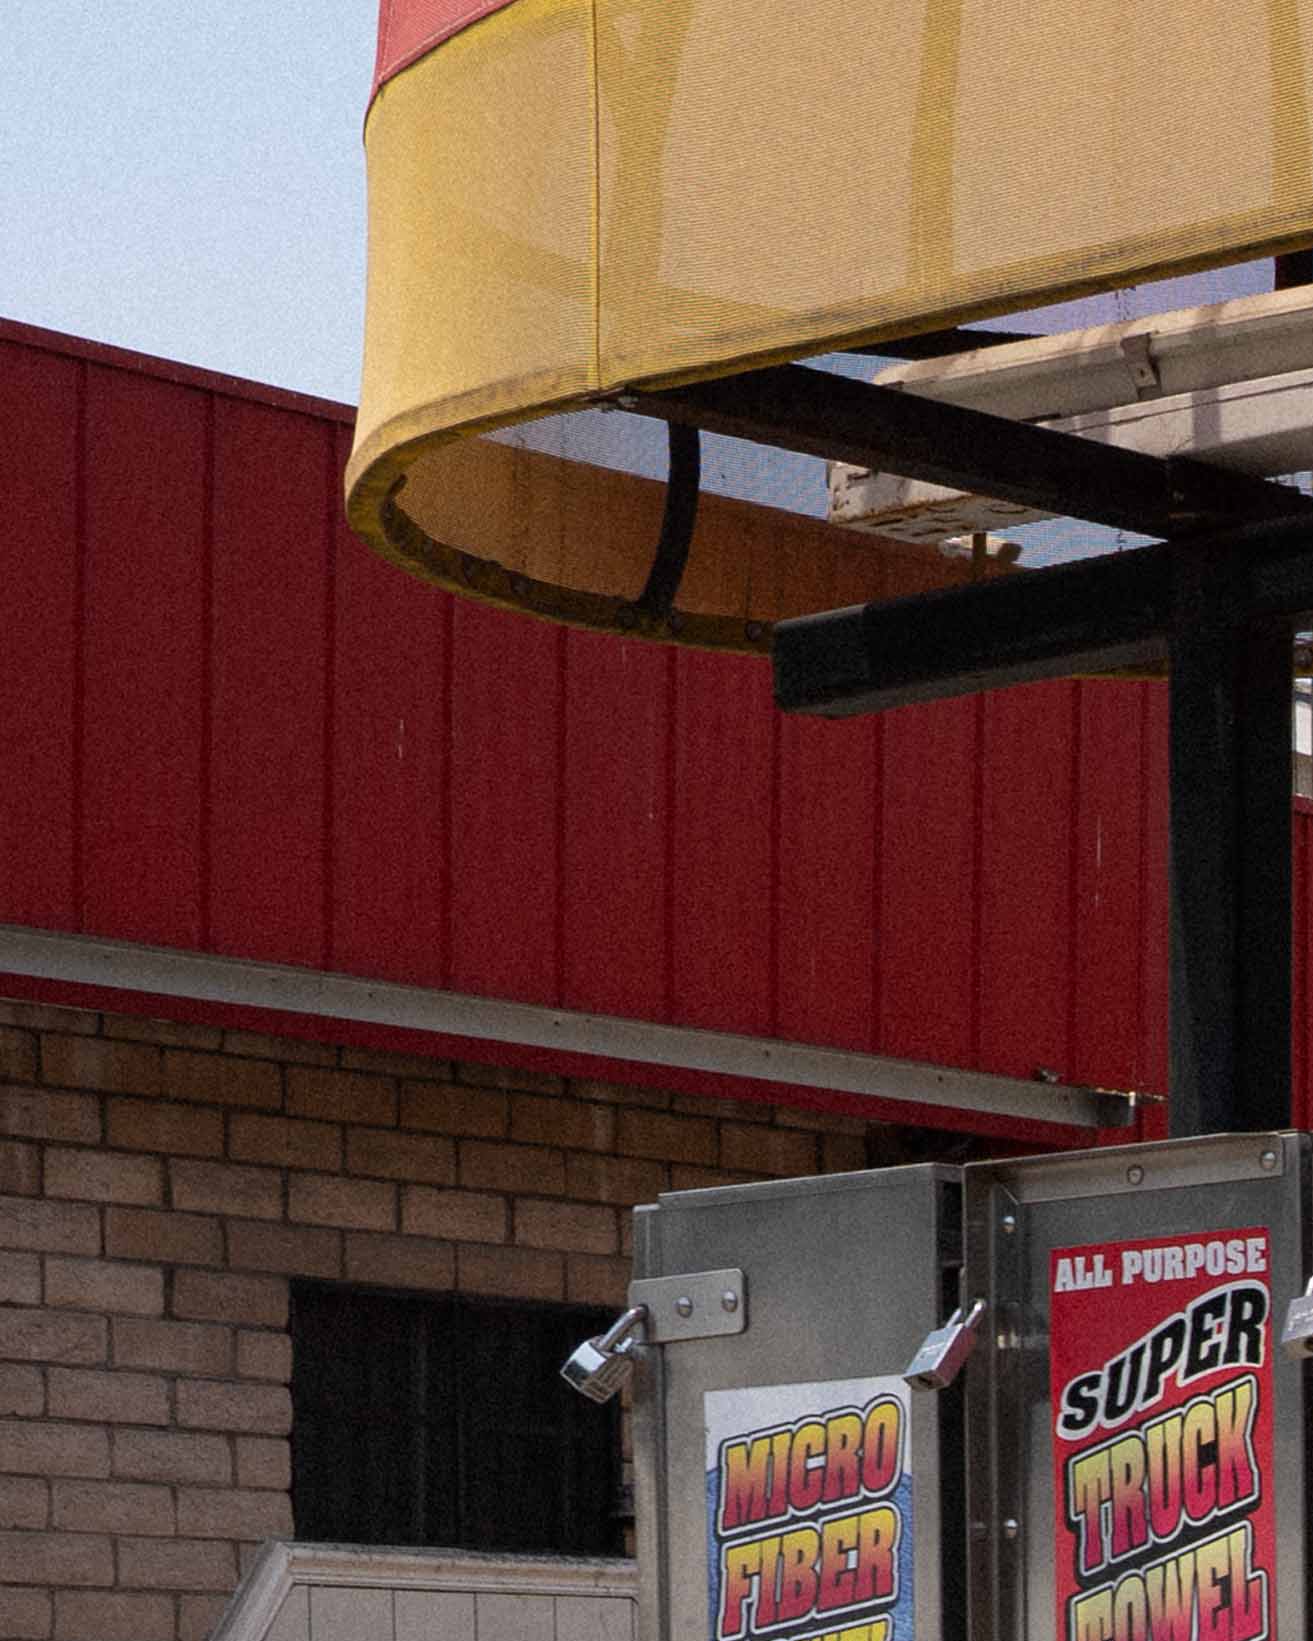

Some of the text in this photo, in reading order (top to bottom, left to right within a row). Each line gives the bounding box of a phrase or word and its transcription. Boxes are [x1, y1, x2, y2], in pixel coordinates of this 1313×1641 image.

[1053, 1238, 1267, 1291] ALL PURPOSE
[1060, 1284, 1268, 1436] SUPER
[721, 1397, 903, 1530] MICRO
[1073, 1383, 1256, 1573] TRUCK
[722, 1508, 899, 1638] FIBER
